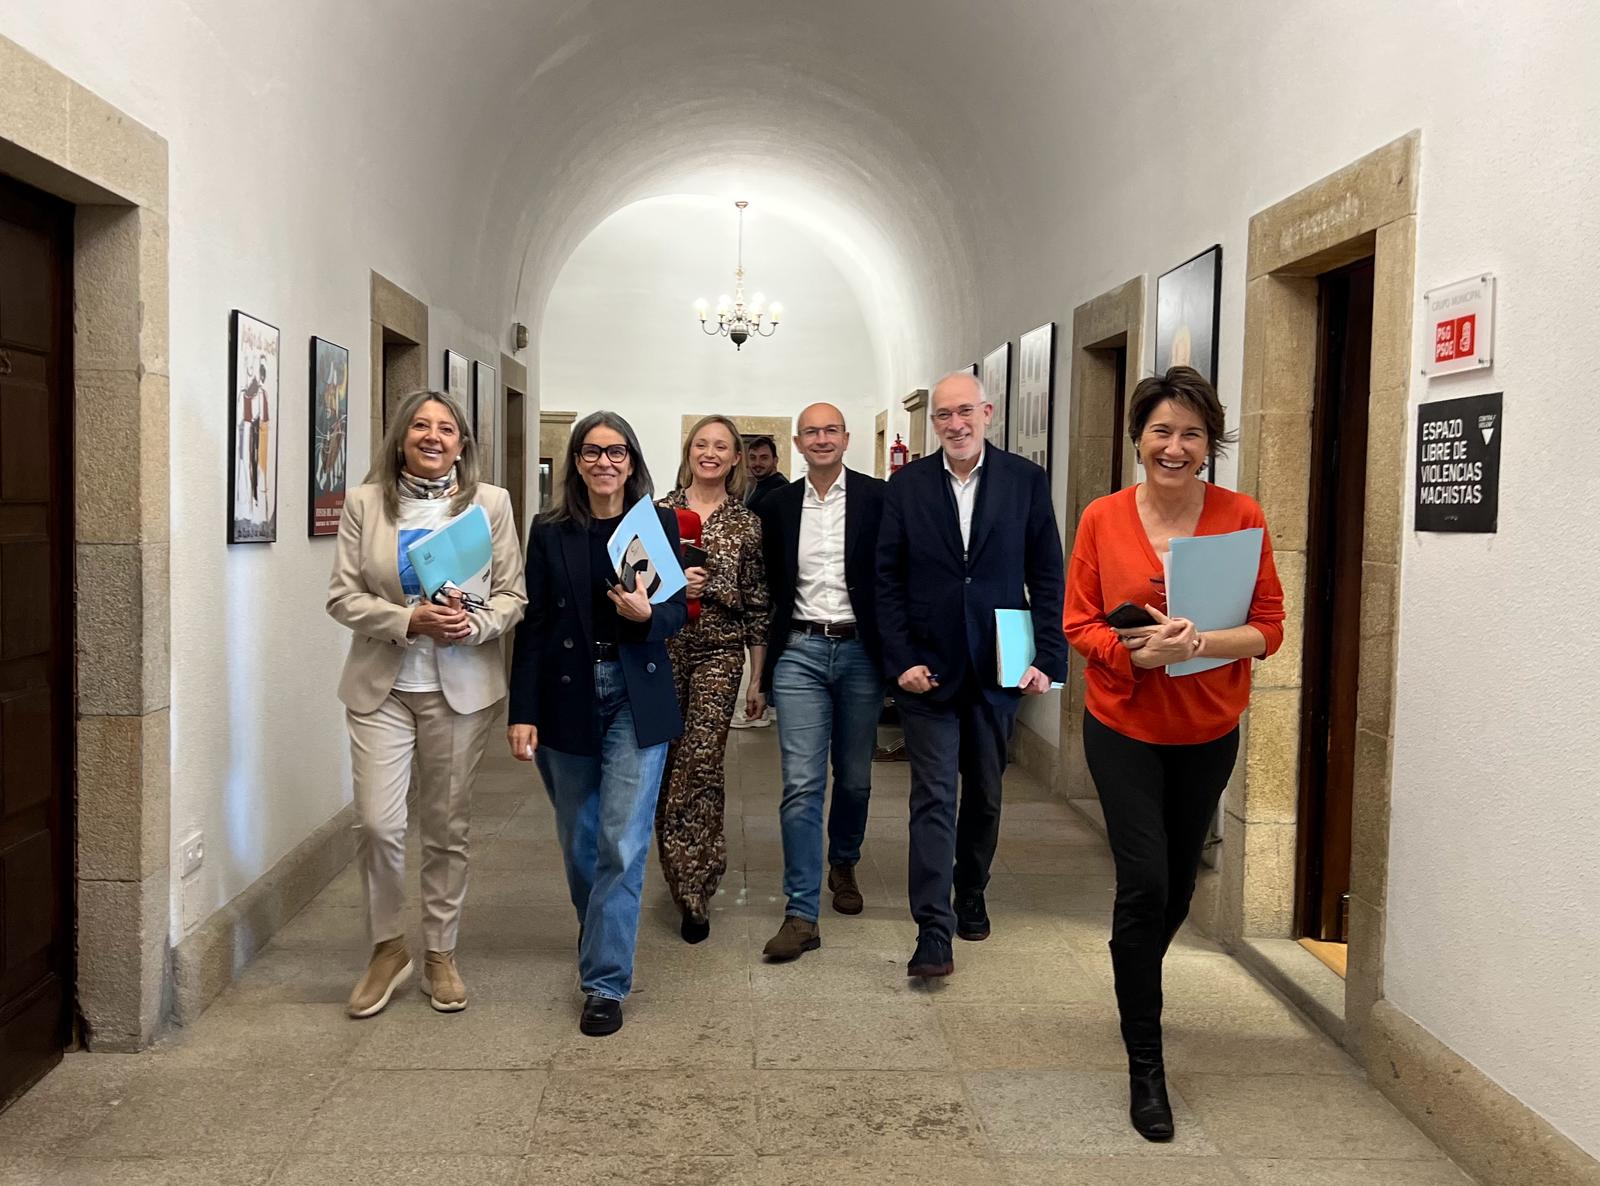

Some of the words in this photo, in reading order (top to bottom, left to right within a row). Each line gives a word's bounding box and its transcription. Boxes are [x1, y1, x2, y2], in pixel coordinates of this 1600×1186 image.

[1436, 340, 1454, 358] PSOE
[1422, 418, 1463, 441] ESPAZO
[1421, 441, 1451, 462] LIBRE
[1453, 440, 1468, 460] DE
[1421, 461, 1483, 483] VIOLENCIAS
[1420, 484, 1482, 505] MACHISTAS
